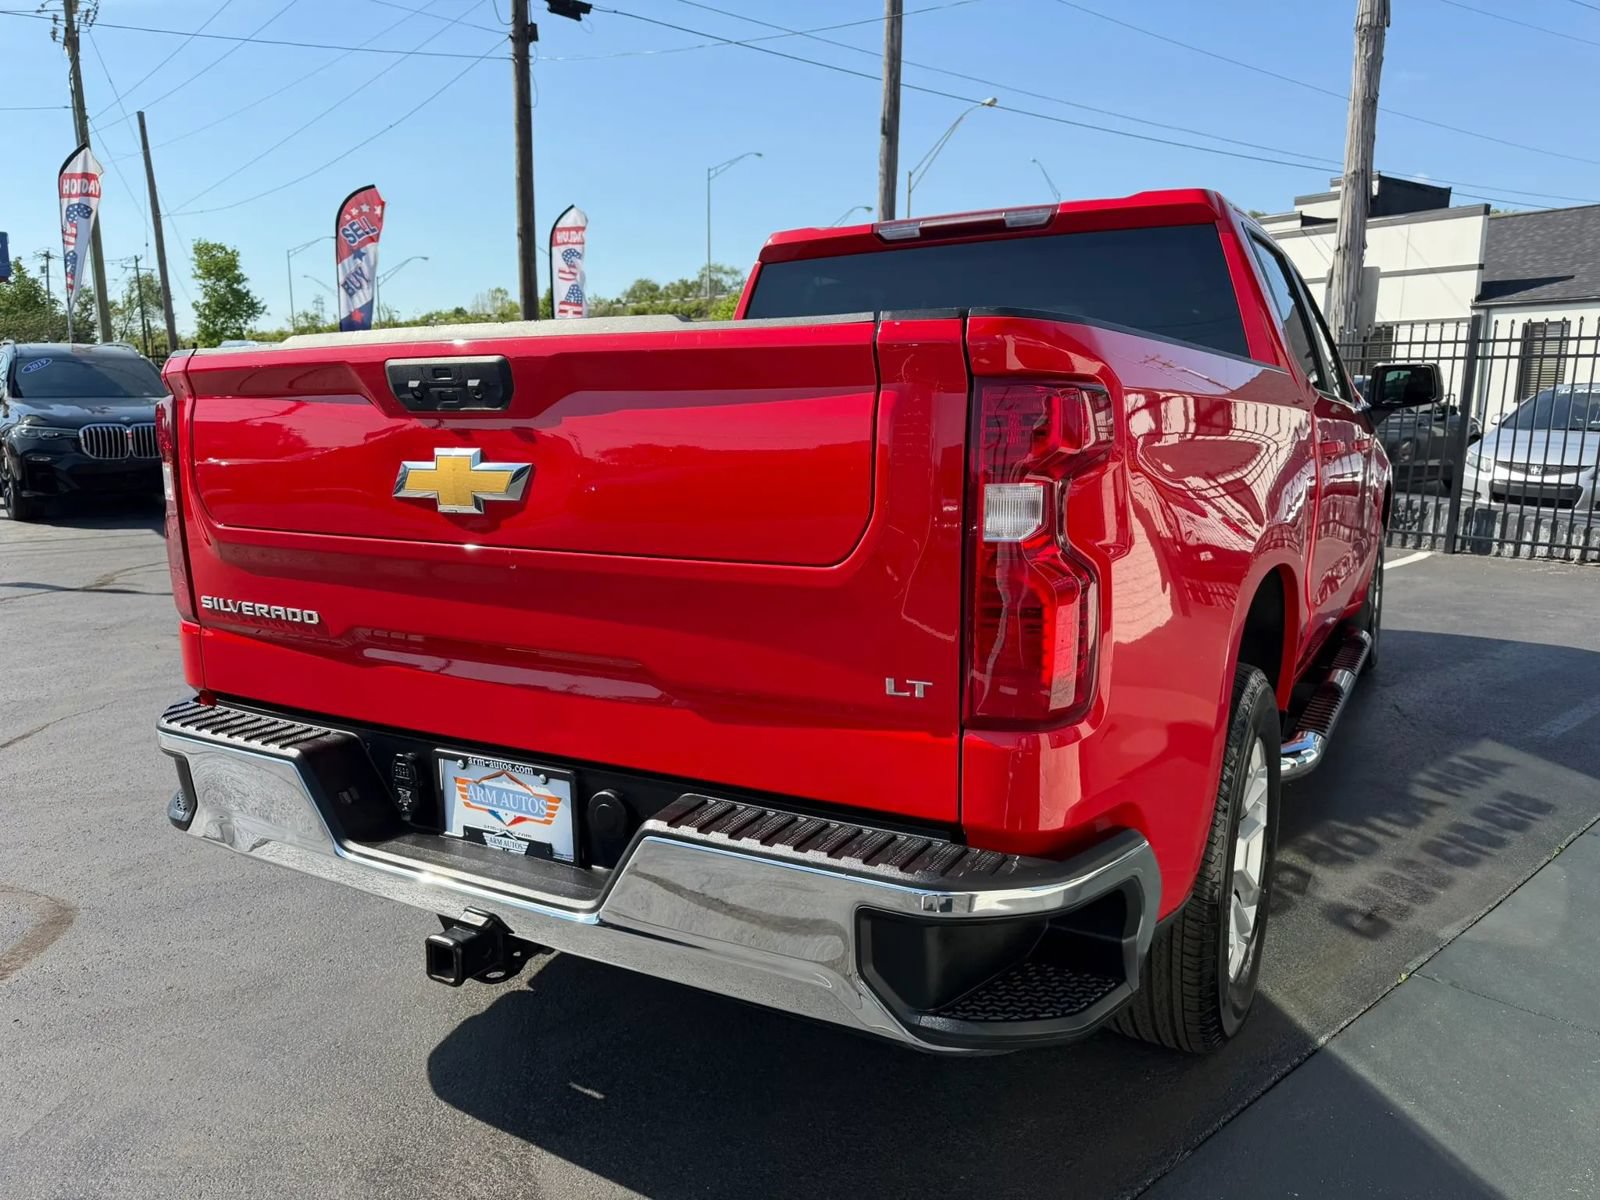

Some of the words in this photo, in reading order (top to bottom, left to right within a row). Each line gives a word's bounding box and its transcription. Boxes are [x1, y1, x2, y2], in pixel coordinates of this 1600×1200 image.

[341, 216, 379, 245] SELL
[341, 266, 369, 297] BUY
[200, 595, 320, 625] SILVERADO
[885, 677, 933, 698] LT
[467, 756, 534, 775] arm-autos.com
[467, 784, 497, 805] ARM
[500, 791, 547, 815] AUTOS
[489, 837, 502, 846] ARM
[503, 840, 523, 850] AUTOS
